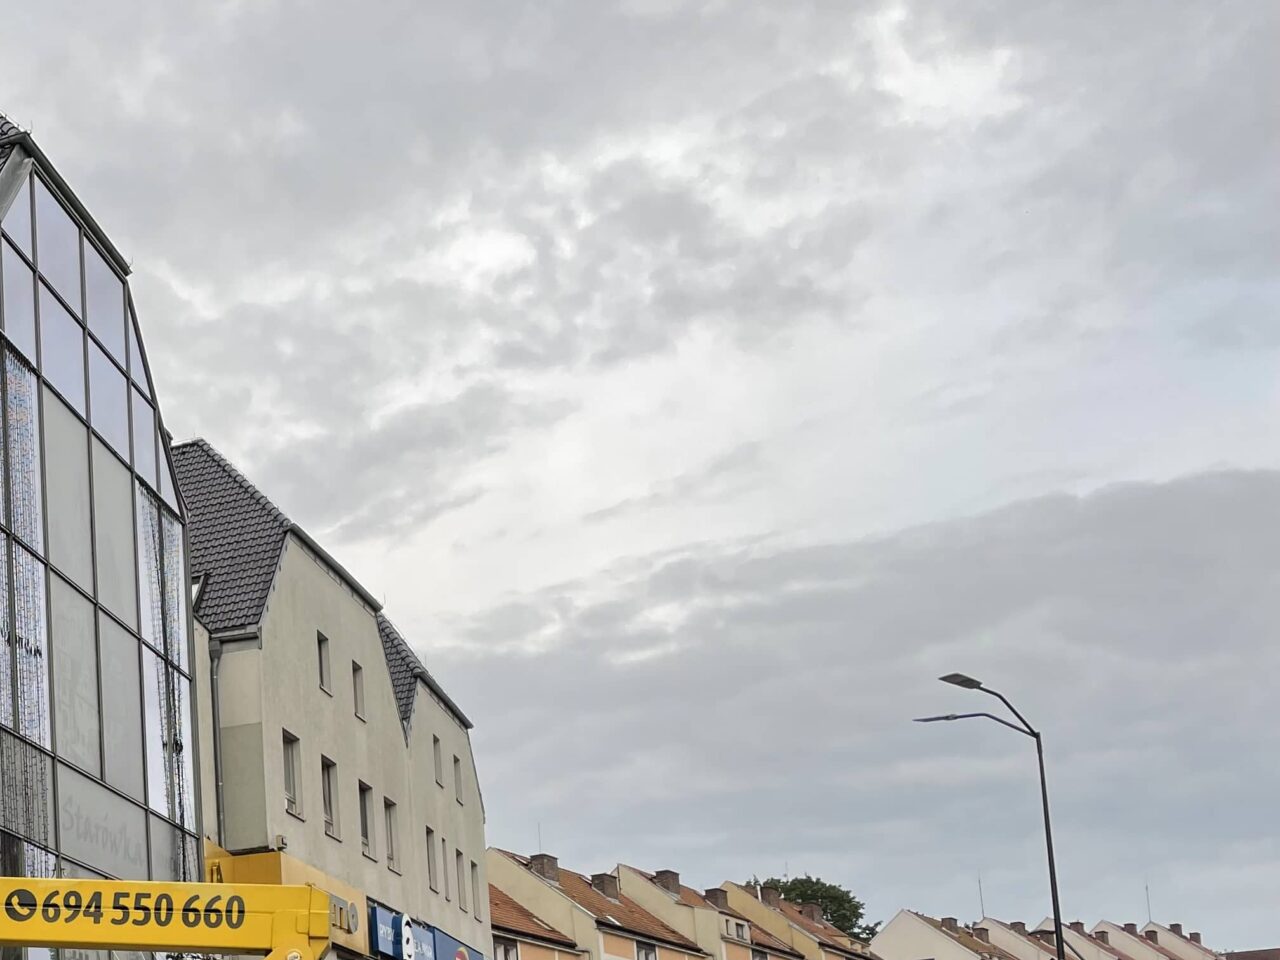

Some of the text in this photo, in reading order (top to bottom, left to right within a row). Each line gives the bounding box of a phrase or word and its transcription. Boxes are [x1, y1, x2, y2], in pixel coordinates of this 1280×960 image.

[41, 889, 246, 929] 694 550 660
